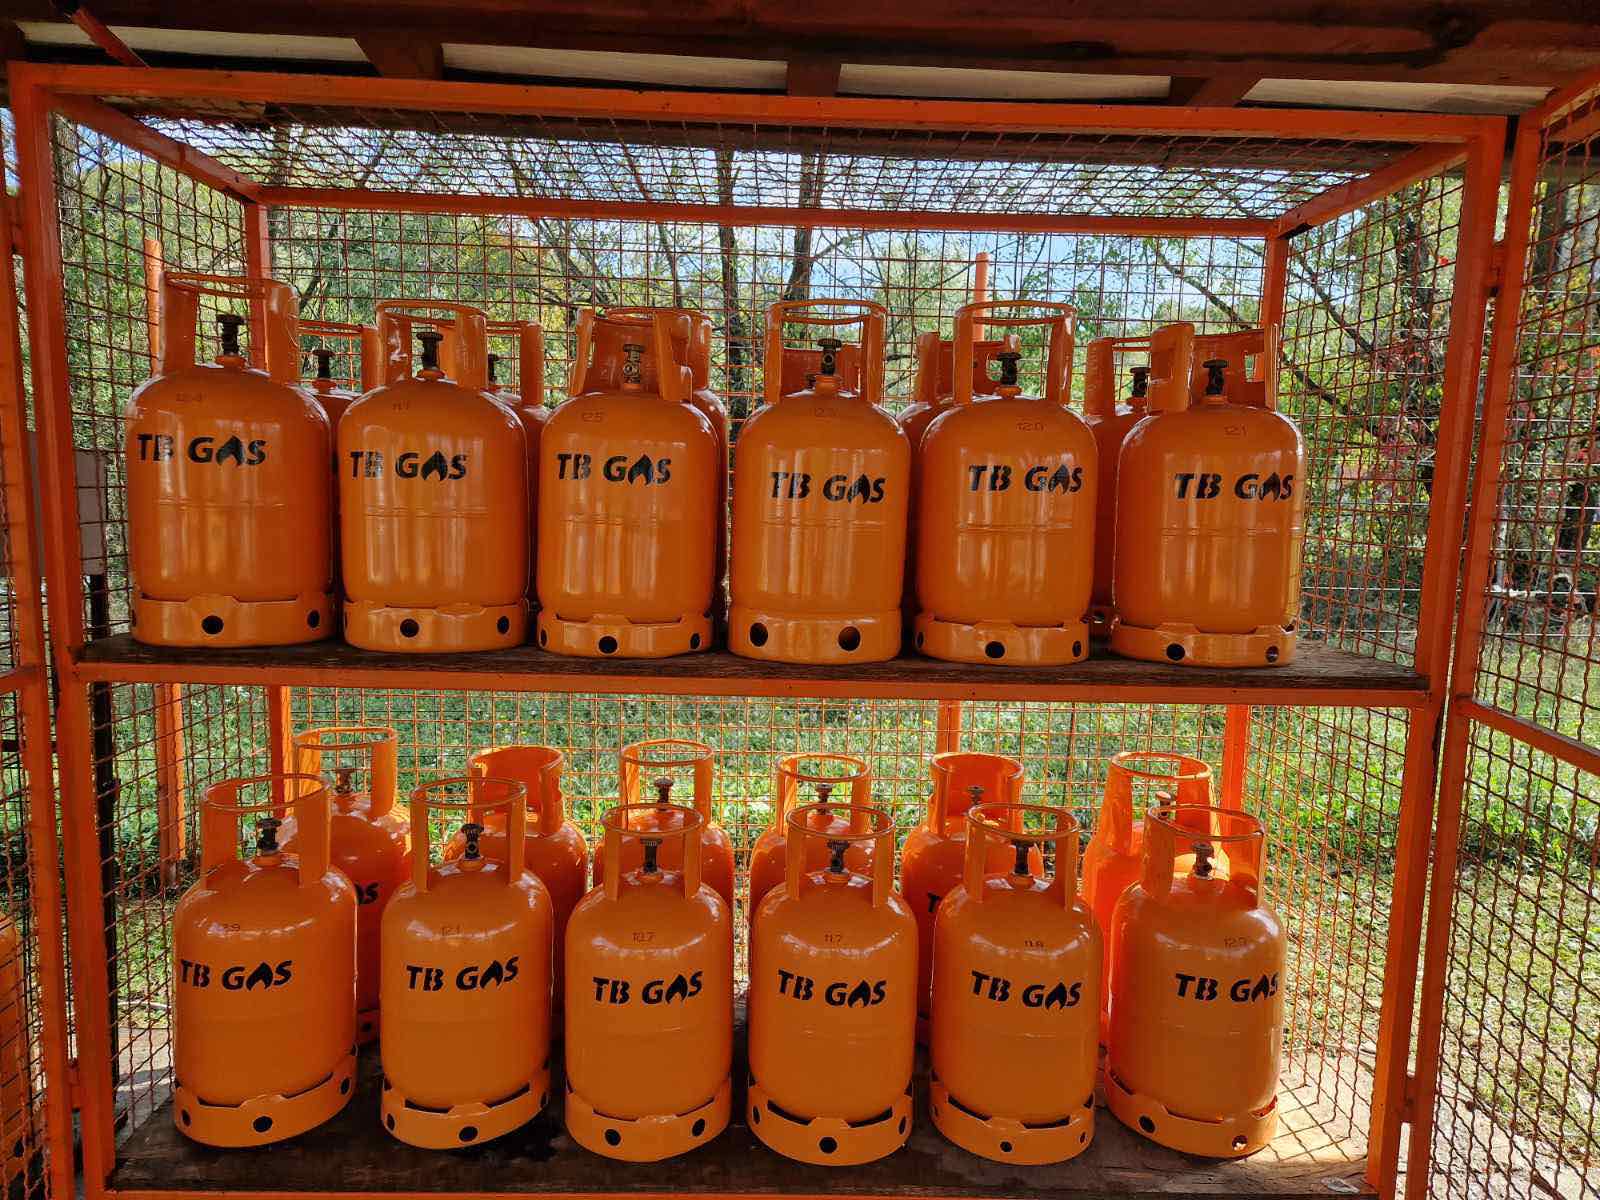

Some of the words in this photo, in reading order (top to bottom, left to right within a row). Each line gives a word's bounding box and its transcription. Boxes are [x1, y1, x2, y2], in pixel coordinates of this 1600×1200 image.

[138, 434, 176, 462] TB
[187, 436, 266, 468] GAS
[351, 449, 382, 478] TB
[395, 451, 467, 481] GAS
[557, 454, 591, 480] TB
[602, 454, 672, 485] GAS
[968, 465, 1012, 492] TB
[1024, 464, 1083, 494] GAS
[771, 471, 811, 499] TB
[822, 474, 886, 504] GAS
[1174, 473, 1222, 500] TB
[1233, 472, 1294, 501] GAS
[180, 959, 210, 988] TB
[222, 960, 293, 991] GAS
[406, 965, 444, 992] TB
[456, 956, 519, 991] GAS
[592, 976, 630, 1005] TB
[642, 970, 703, 1005] GAS
[778, 969, 814, 1001] TB
[825, 980, 887, 1008] GAS
[971, 970, 1011, 1002] TB
[1022, 981, 1082, 1010] GAS
[1175, 973, 1219, 1001] TB
[1230, 972, 1280, 1003] GAS
